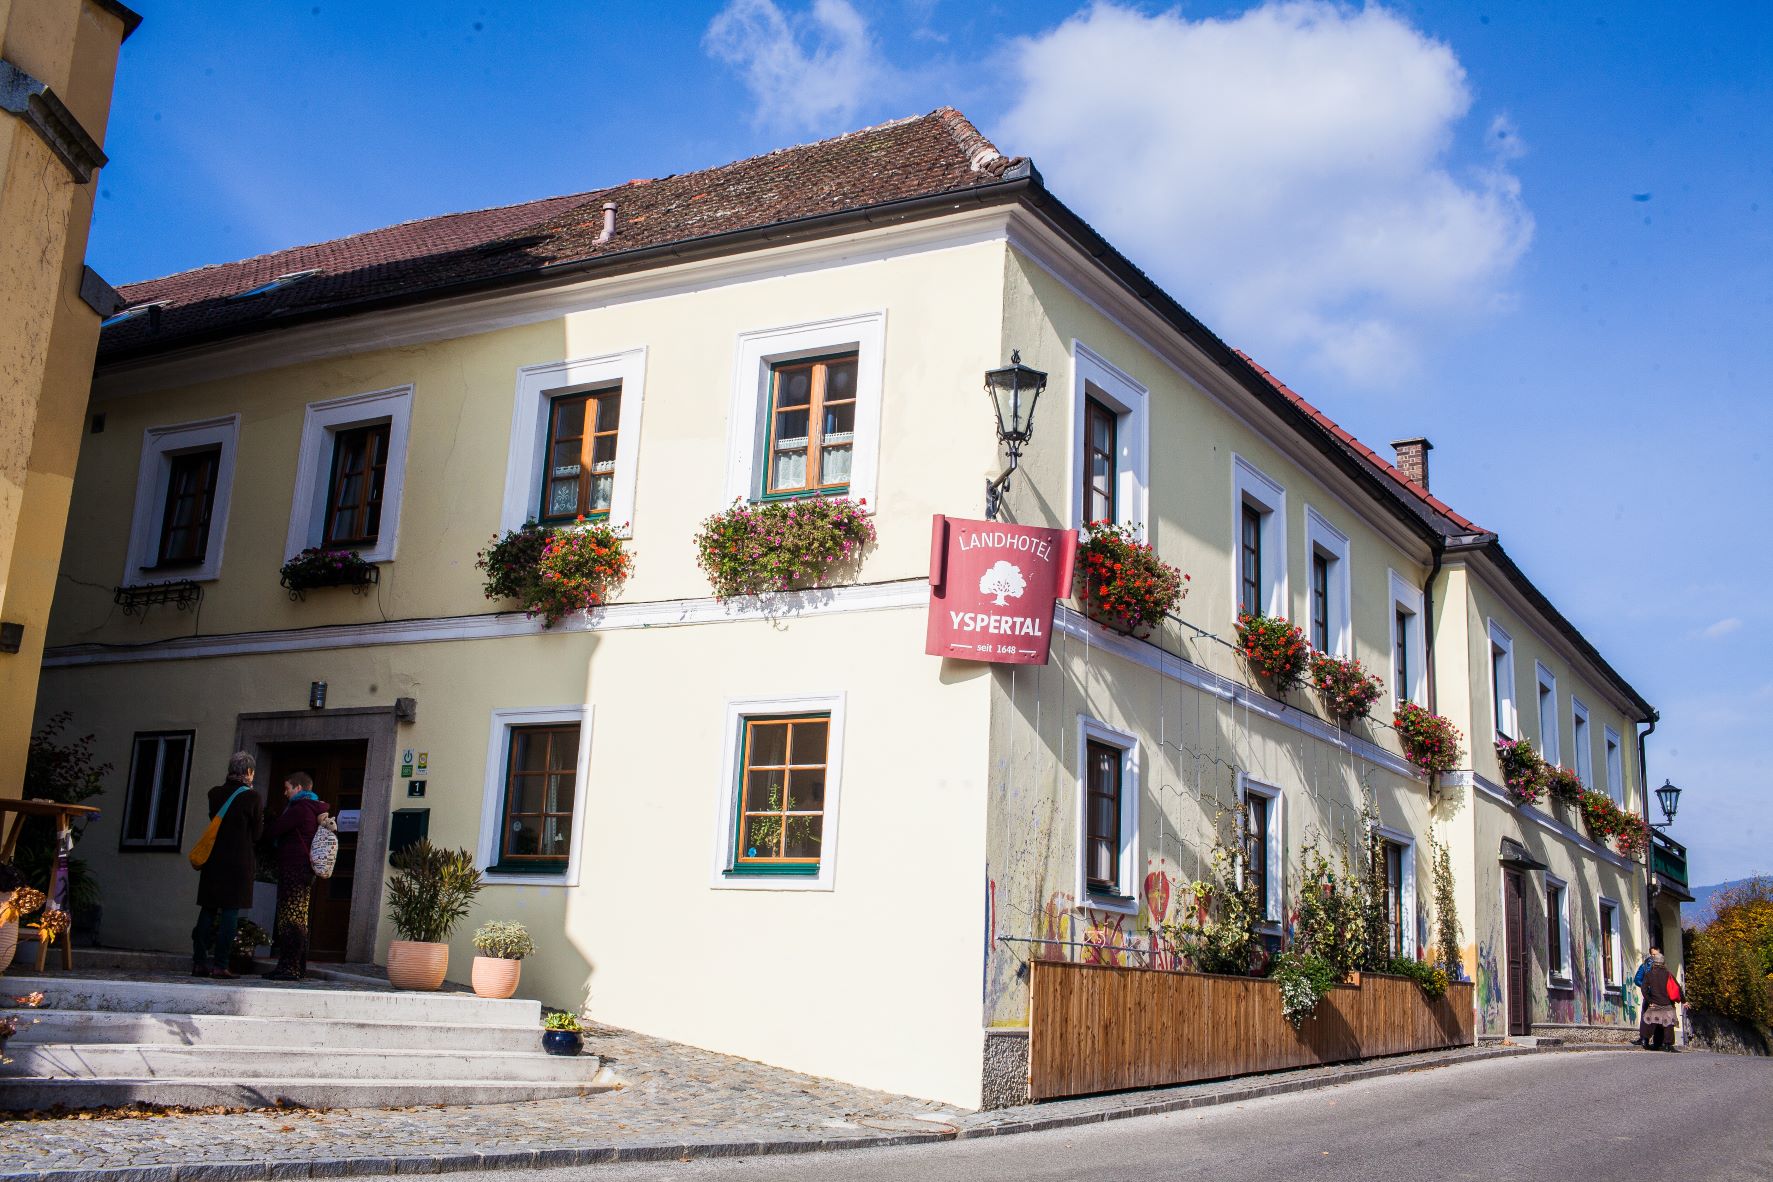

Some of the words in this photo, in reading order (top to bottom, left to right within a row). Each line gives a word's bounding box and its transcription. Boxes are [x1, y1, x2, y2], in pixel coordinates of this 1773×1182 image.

[959, 532, 1051, 562] LANDHOTEL
[950, 611, 1042, 636] YSPERTAL
[976, 644, 992, 653] seit
[996, 645, 1016, 654] 1648
